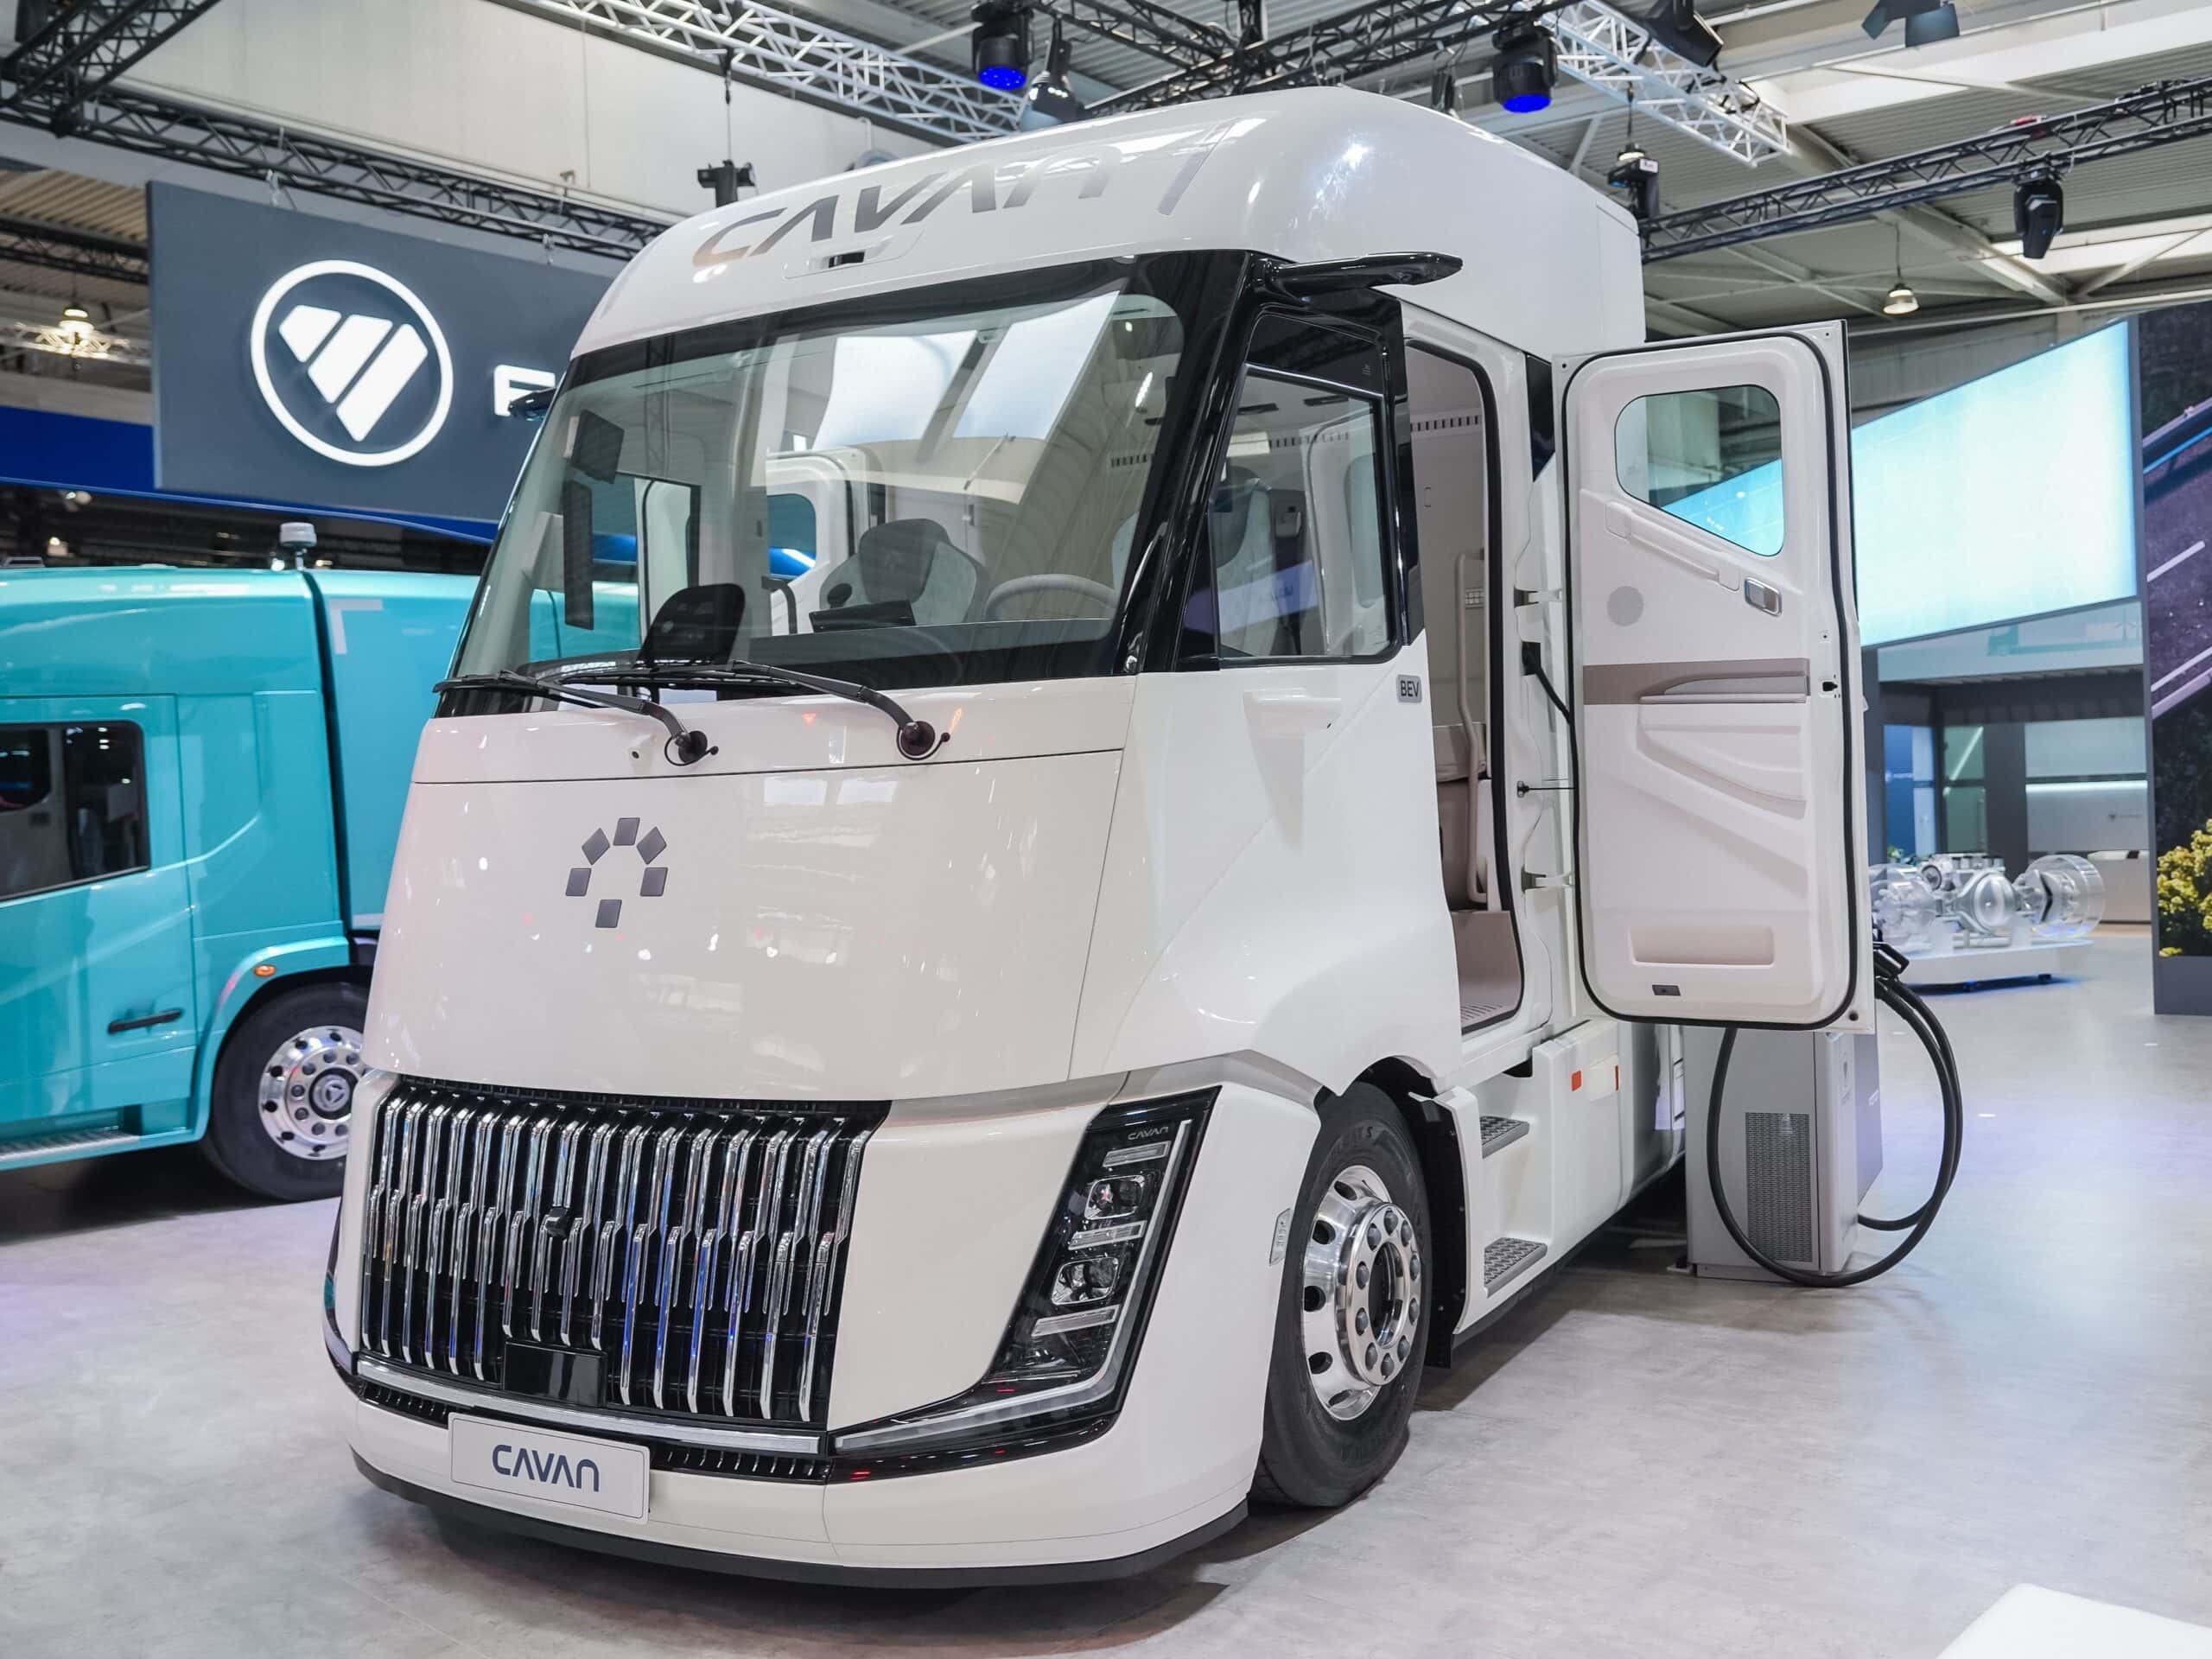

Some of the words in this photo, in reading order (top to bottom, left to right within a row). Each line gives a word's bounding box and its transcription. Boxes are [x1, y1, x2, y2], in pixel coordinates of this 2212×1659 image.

[693, 144, 1122, 266] CAVAN
[1400, 680, 1419, 697] BEV
[1127, 1126, 1169, 1141] CAVAN
[492, 1444, 600, 1492] CAVAN
